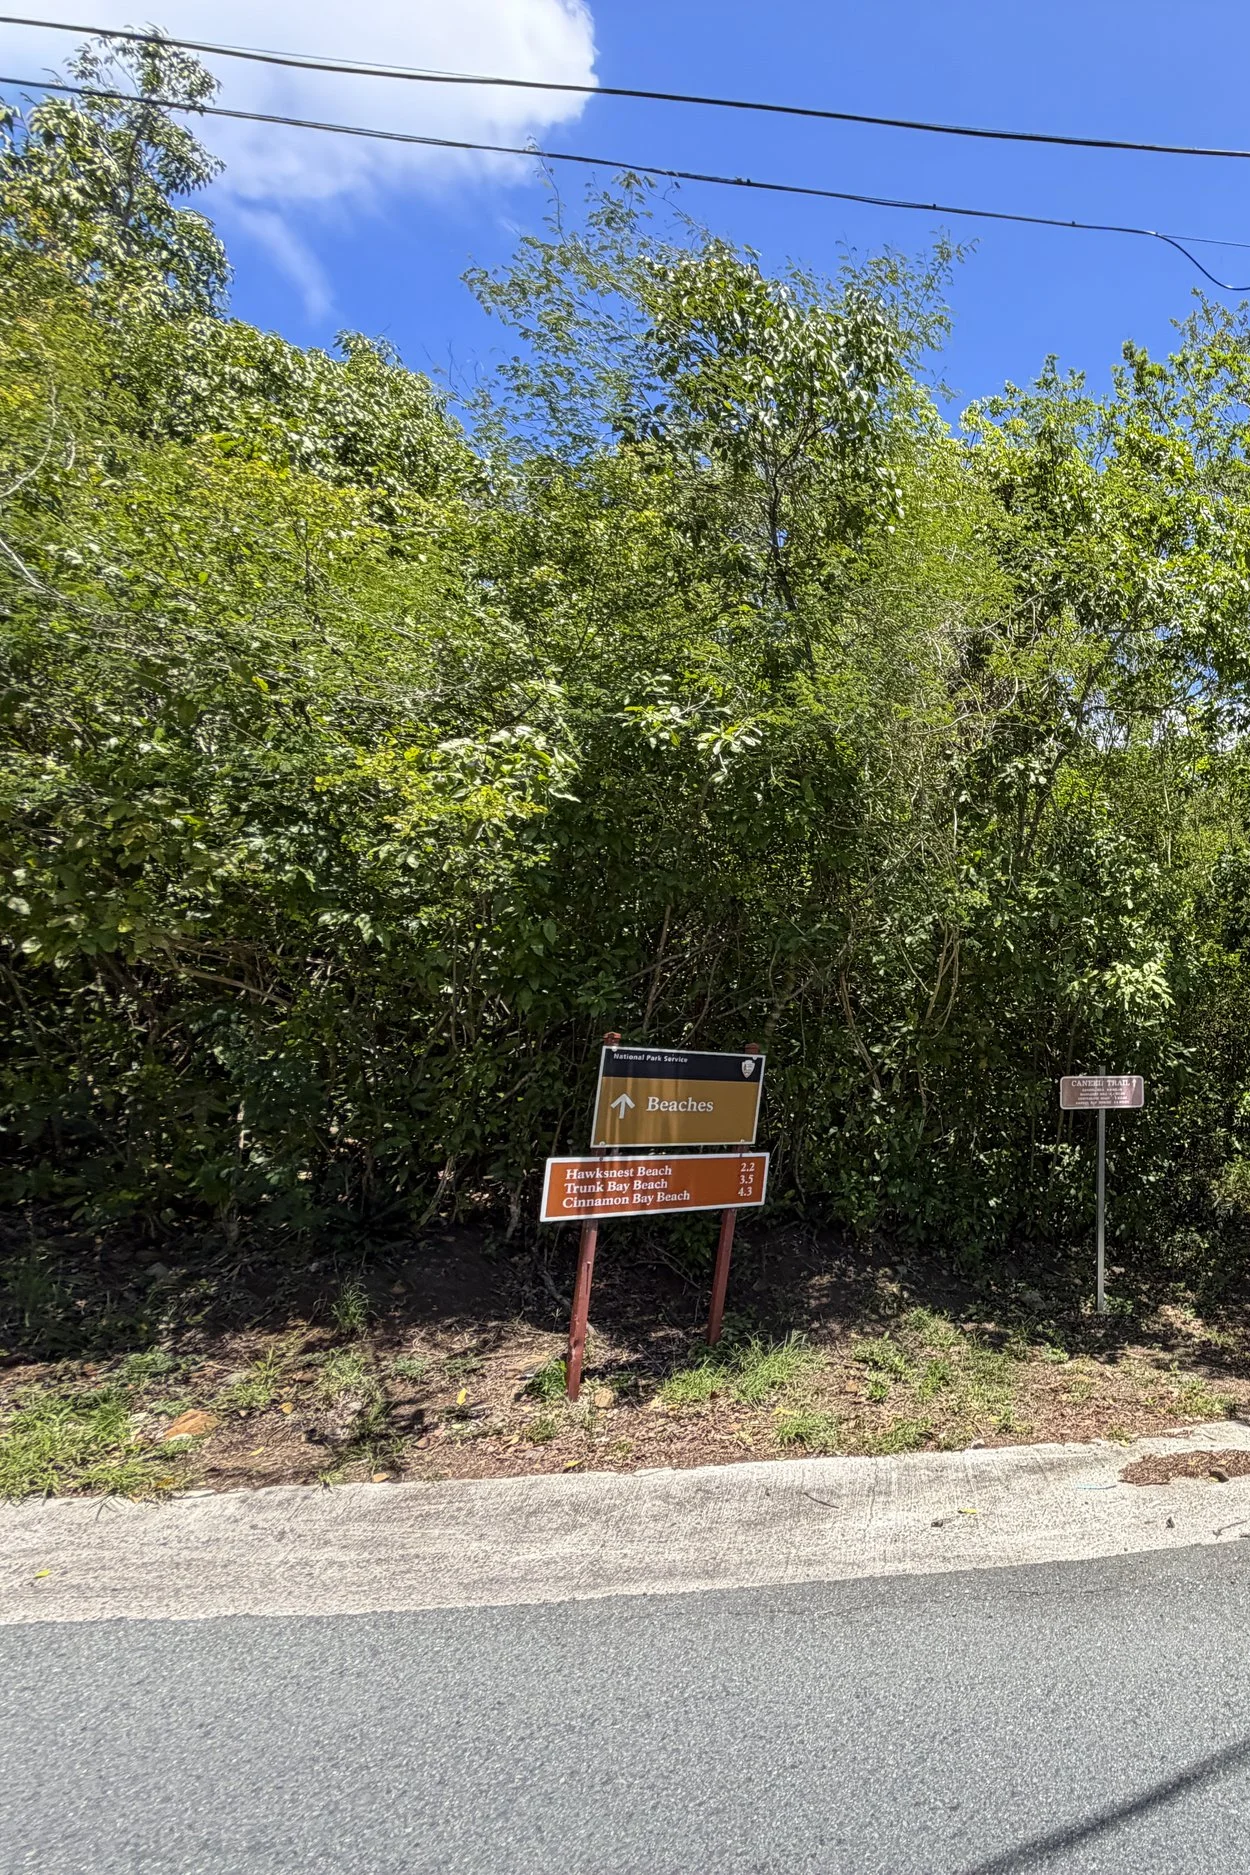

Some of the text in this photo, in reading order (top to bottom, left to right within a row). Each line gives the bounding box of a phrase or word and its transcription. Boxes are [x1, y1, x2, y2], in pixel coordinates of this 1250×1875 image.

[613, 1052, 688, 1063] National Park Service
[646, 1096, 714, 1112] Beaches
[566, 1162, 755, 1180] Hawksnest Beach 2.2
[564, 1174, 754, 1194] Trunk Bay Beach 3.5
[562, 1187, 753, 1208] Cinnamon Bay Beach 4.3
